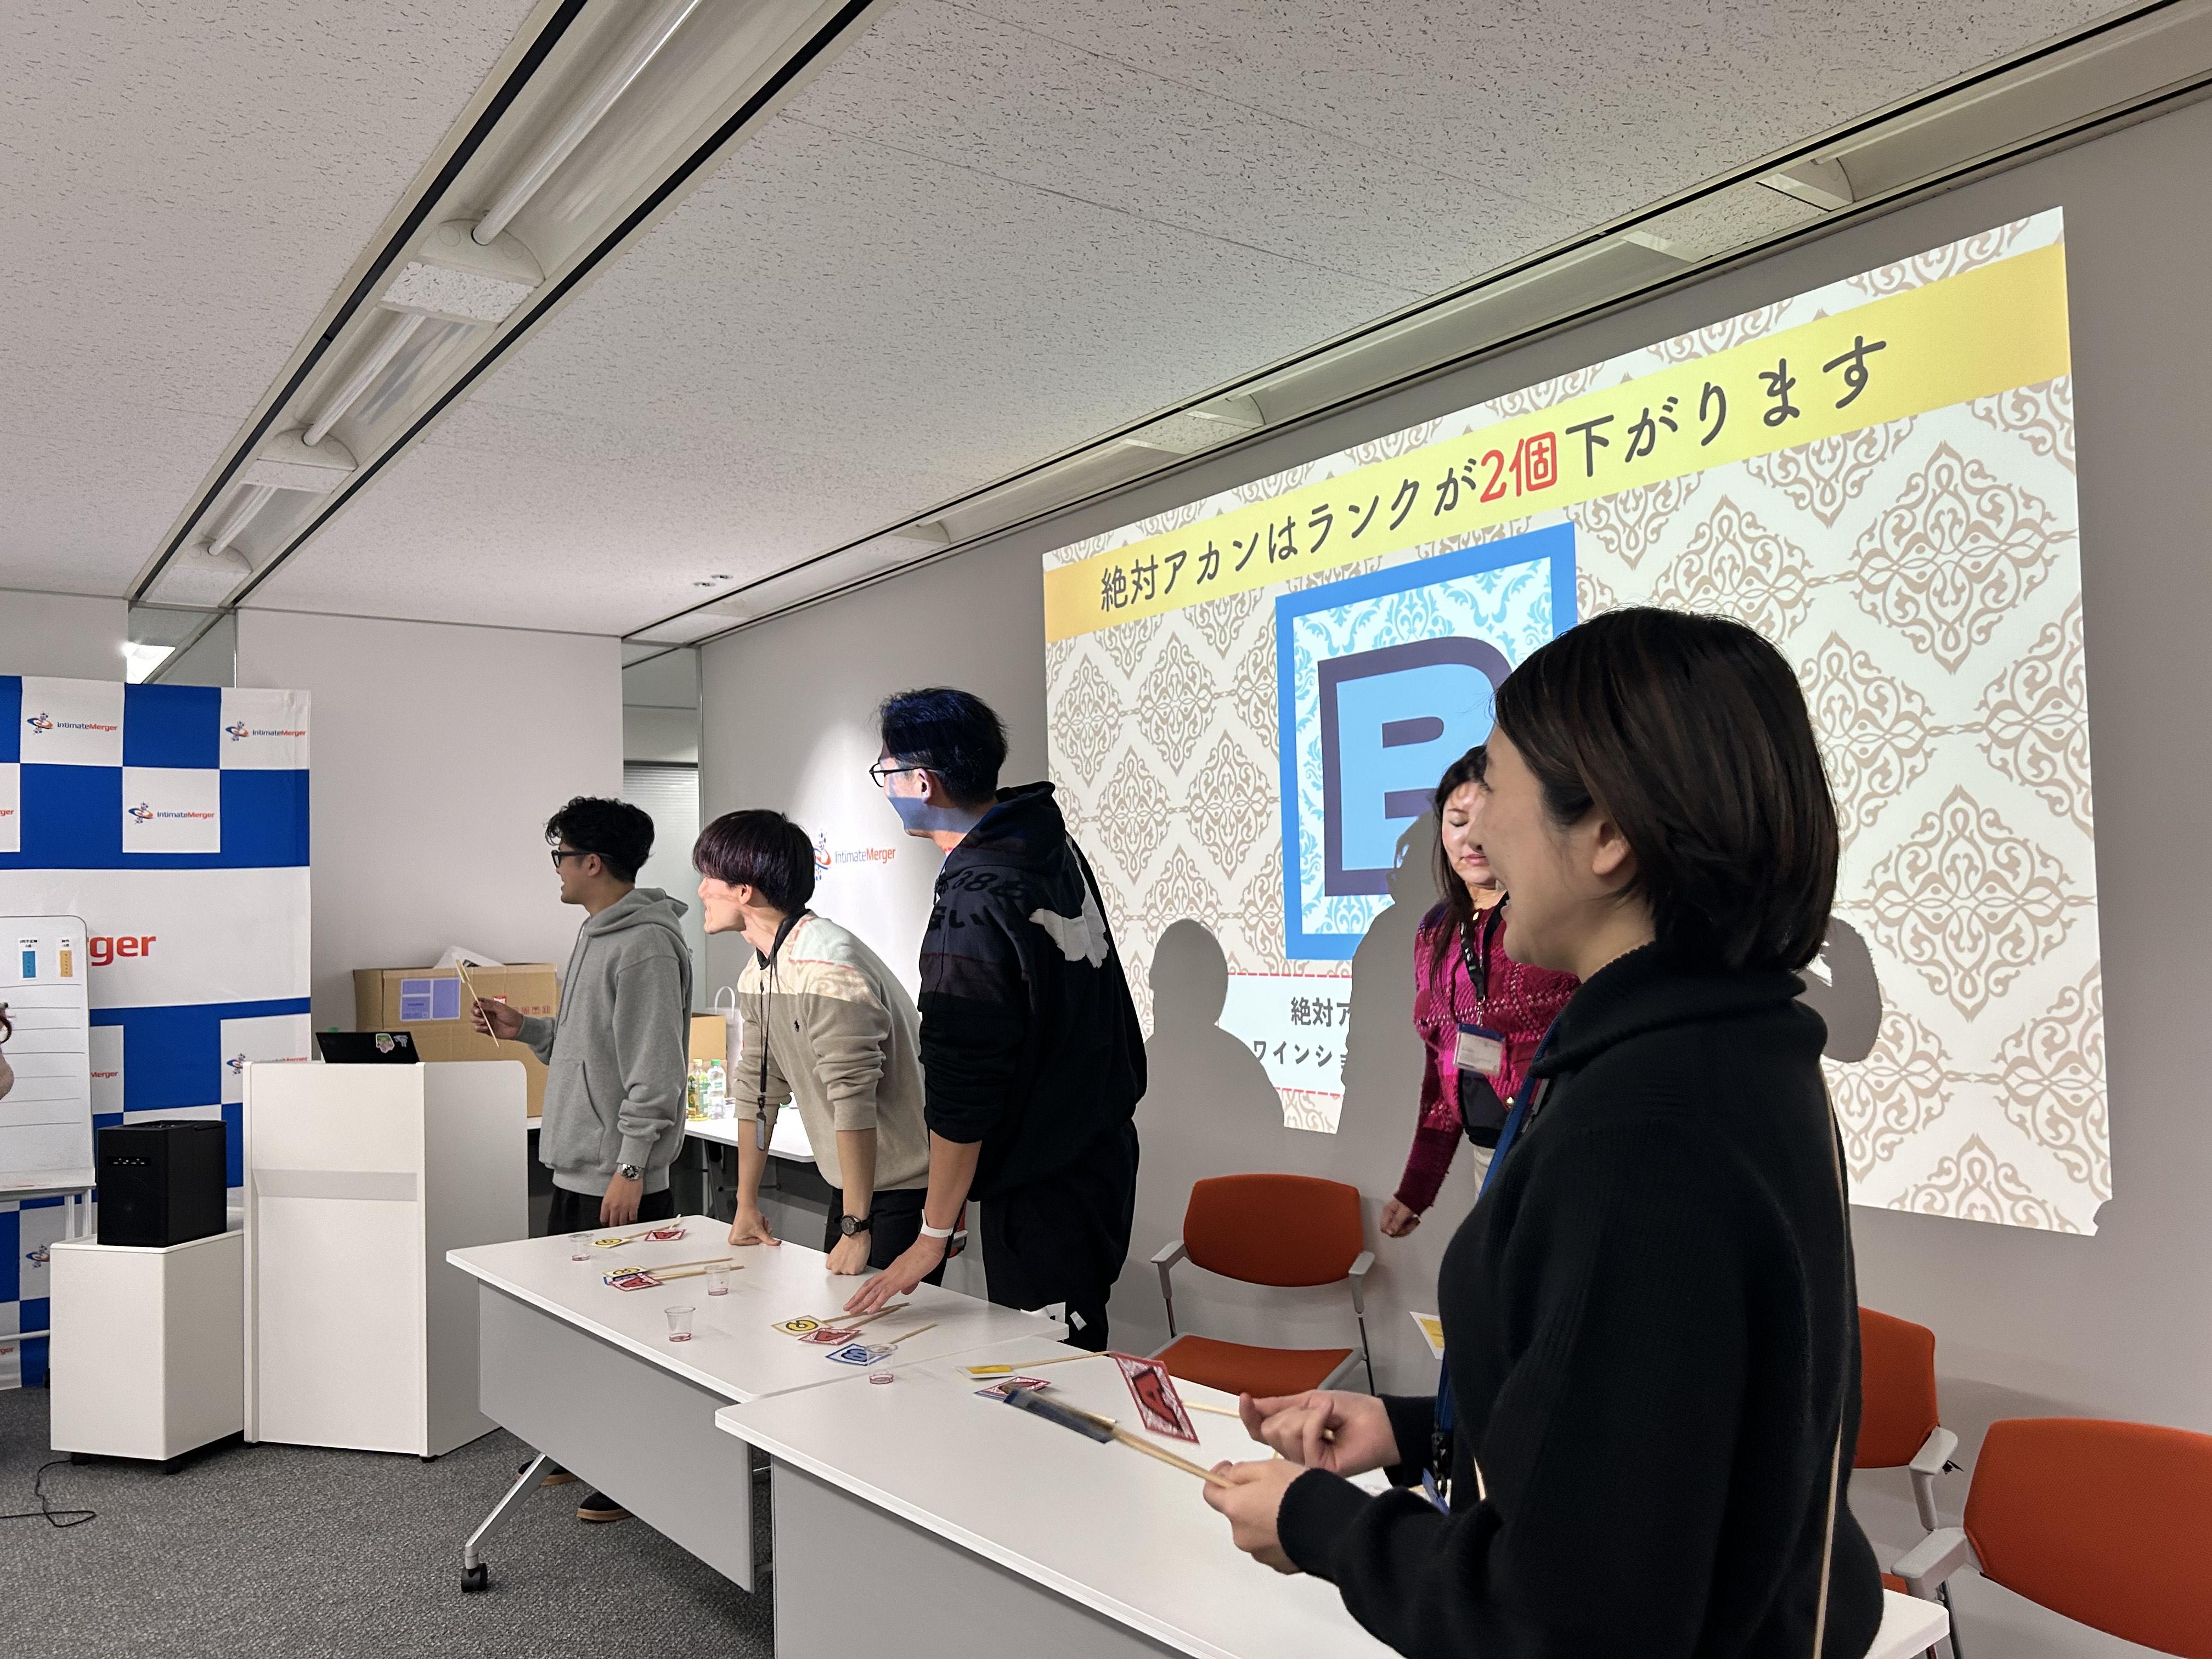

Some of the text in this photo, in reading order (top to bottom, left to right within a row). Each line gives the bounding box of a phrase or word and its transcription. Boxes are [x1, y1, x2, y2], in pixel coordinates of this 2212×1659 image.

[1101, 335, 1887, 612] 絶対アカンはランクが2個下がります
[57, 722, 117, 731] IntimateMerger
[157, 811, 215, 820] IntimateMerger
[835, 848, 896, 864] IntimateMerger
[87, 936, 156, 966] ger
